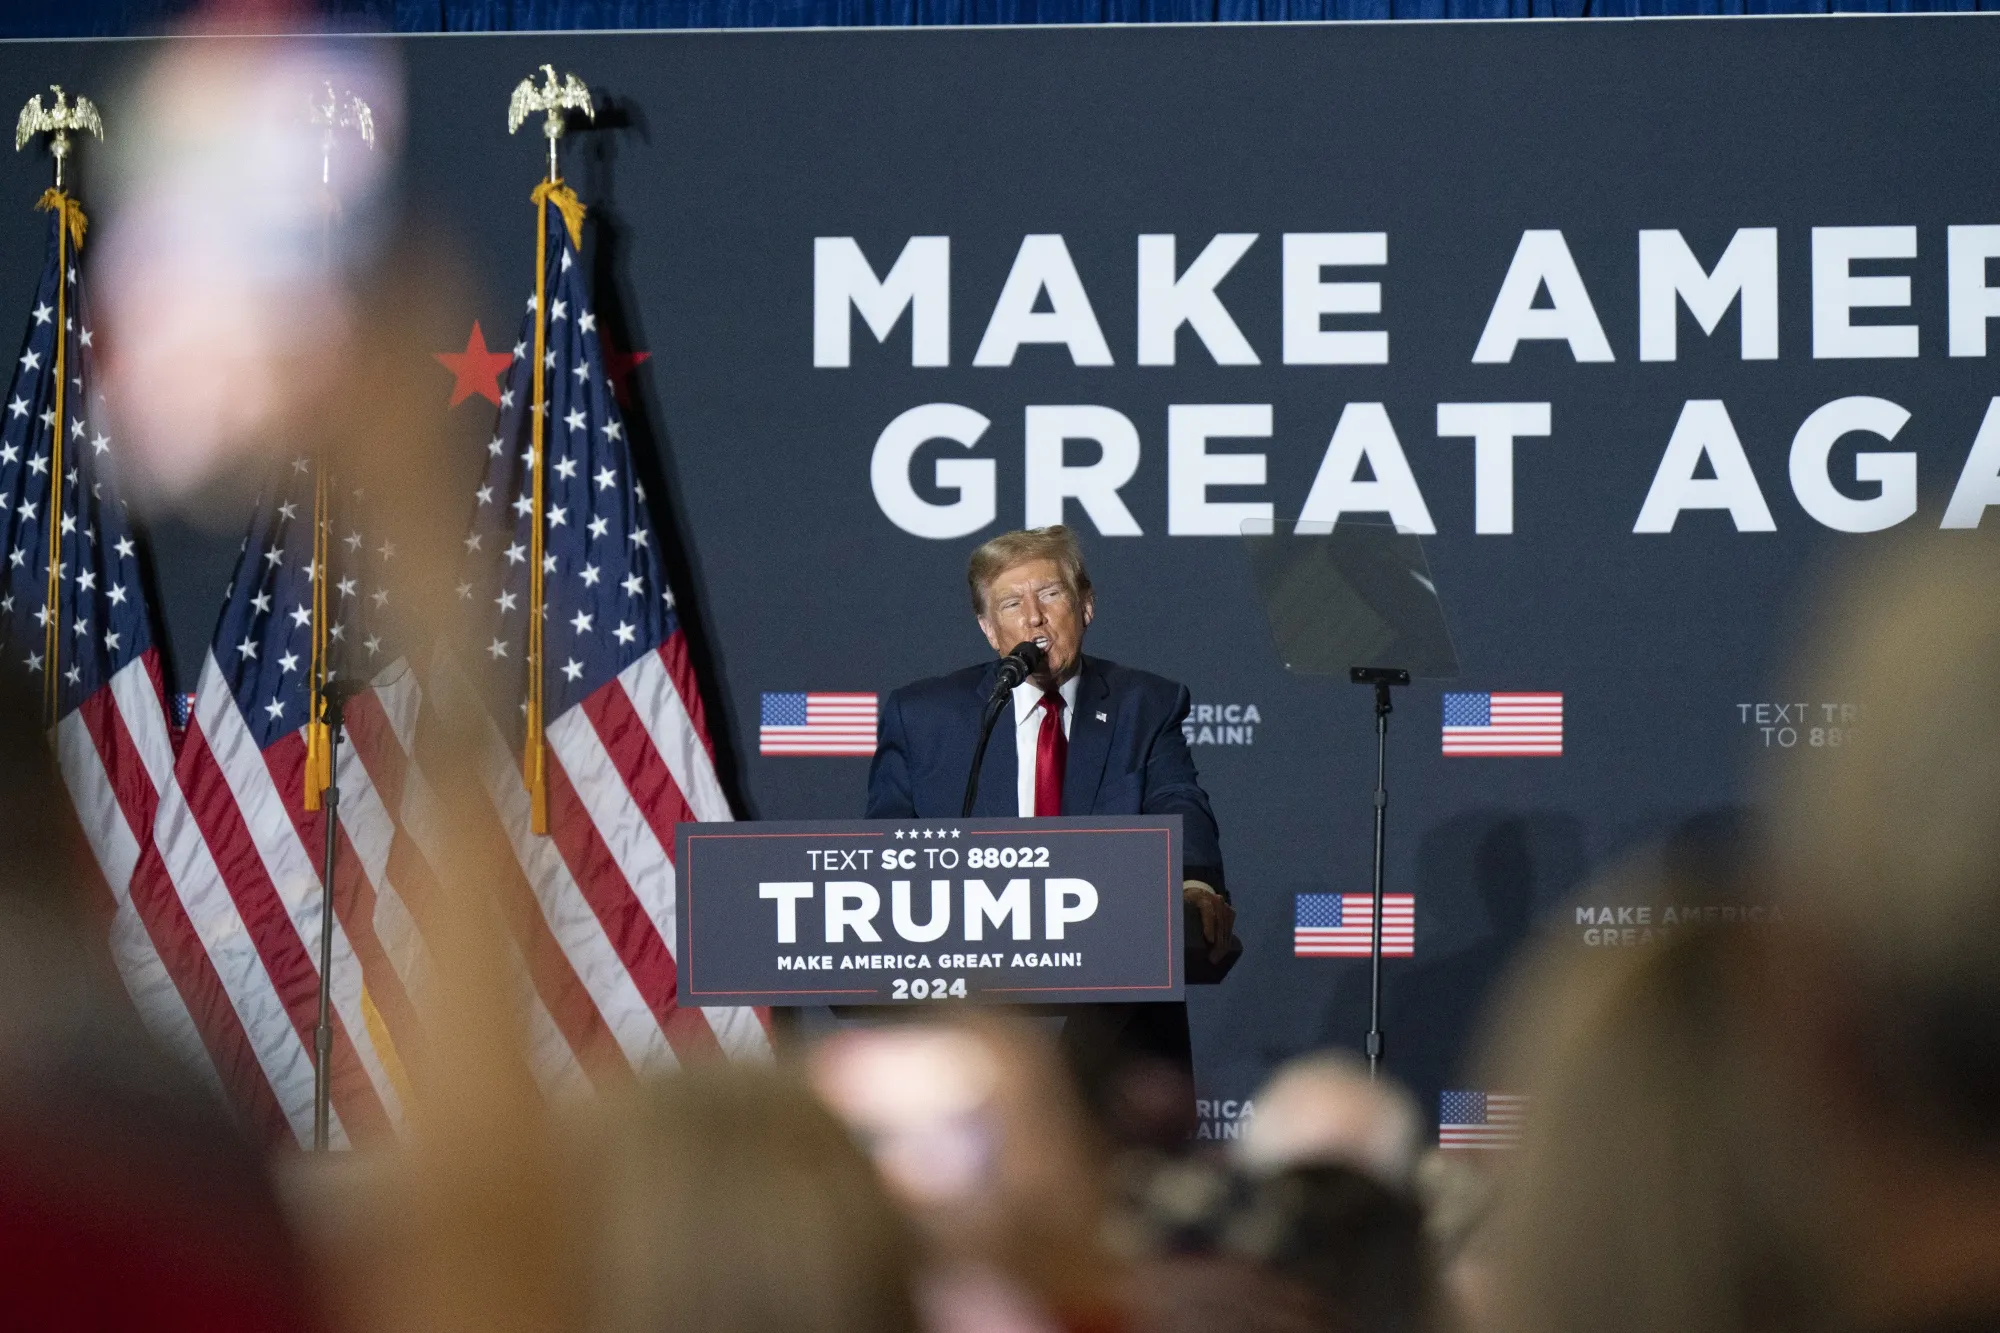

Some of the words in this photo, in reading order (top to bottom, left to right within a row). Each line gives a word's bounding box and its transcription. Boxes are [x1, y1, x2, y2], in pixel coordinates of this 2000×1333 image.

[813, 231, 1389, 368] MAKE
[870, 401, 1552, 540] GREAT
[1736, 703, 1809, 724] TEXT
[1760, 727, 1797, 748] TO
[806, 849, 874, 871] TEXT
[880, 848, 917, 871] SC
[924, 848, 960, 870] TO
[966, 846, 1050, 869] 88022
[758, 877, 1100, 944] TRUMP
[1575, 907, 1652, 925] MAKE
[777, 955, 834, 971] MAKE
[840, 954, 932, 970] AMERICA
[938, 953, 1004, 969] GREAT
[1011, 951, 1083, 968] AGAIN!
[891, 978, 968, 1001] 2024
